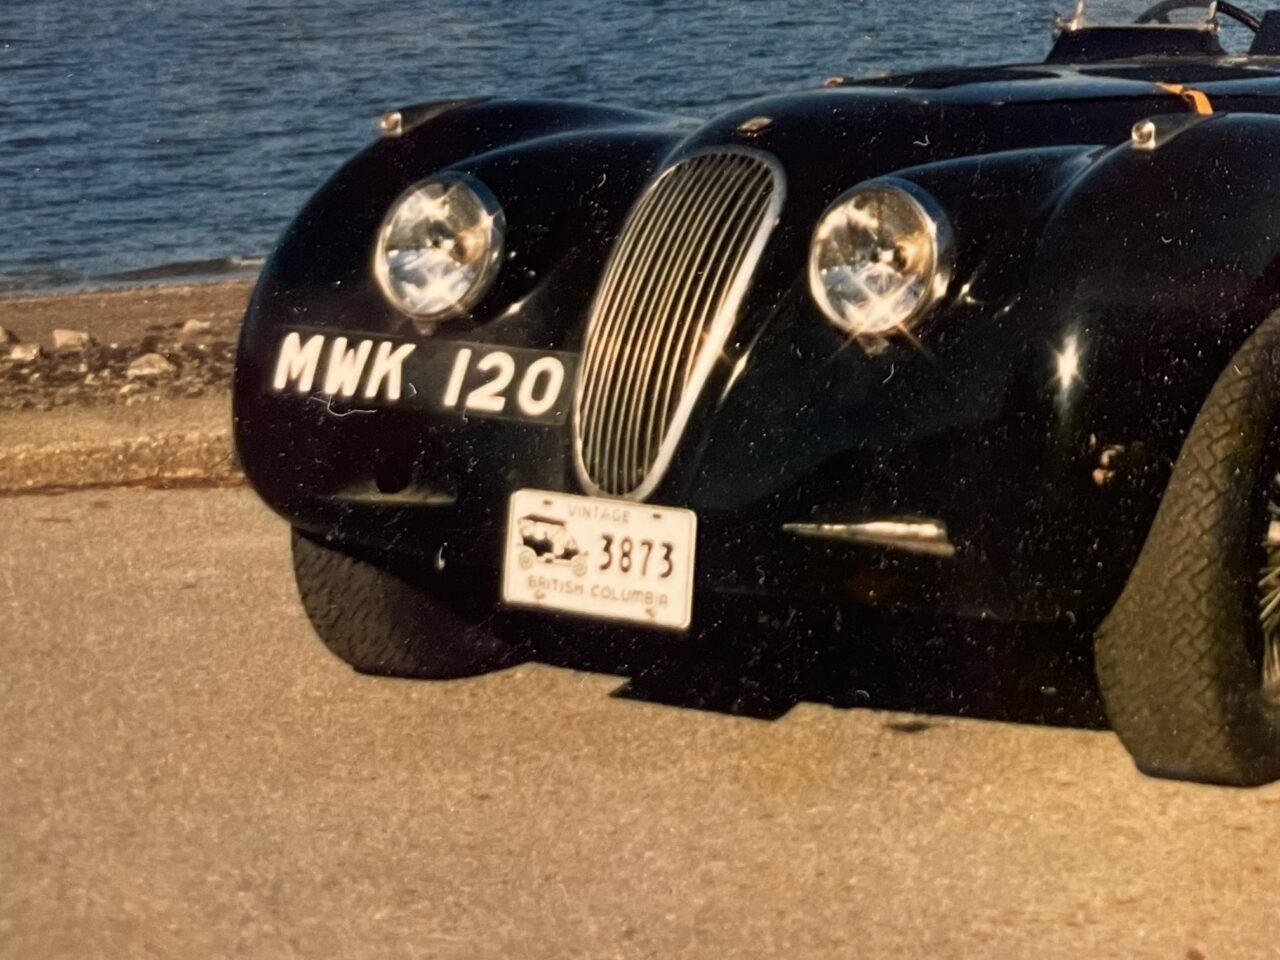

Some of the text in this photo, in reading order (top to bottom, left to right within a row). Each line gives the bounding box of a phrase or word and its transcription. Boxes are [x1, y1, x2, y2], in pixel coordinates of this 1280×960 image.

[273, 332, 565, 416] MWK 120
[568, 504, 631, 523] VINTAGE
[599, 533, 674, 578] 3873
[528, 575, 668, 607] BRITISH COLUMBIA
